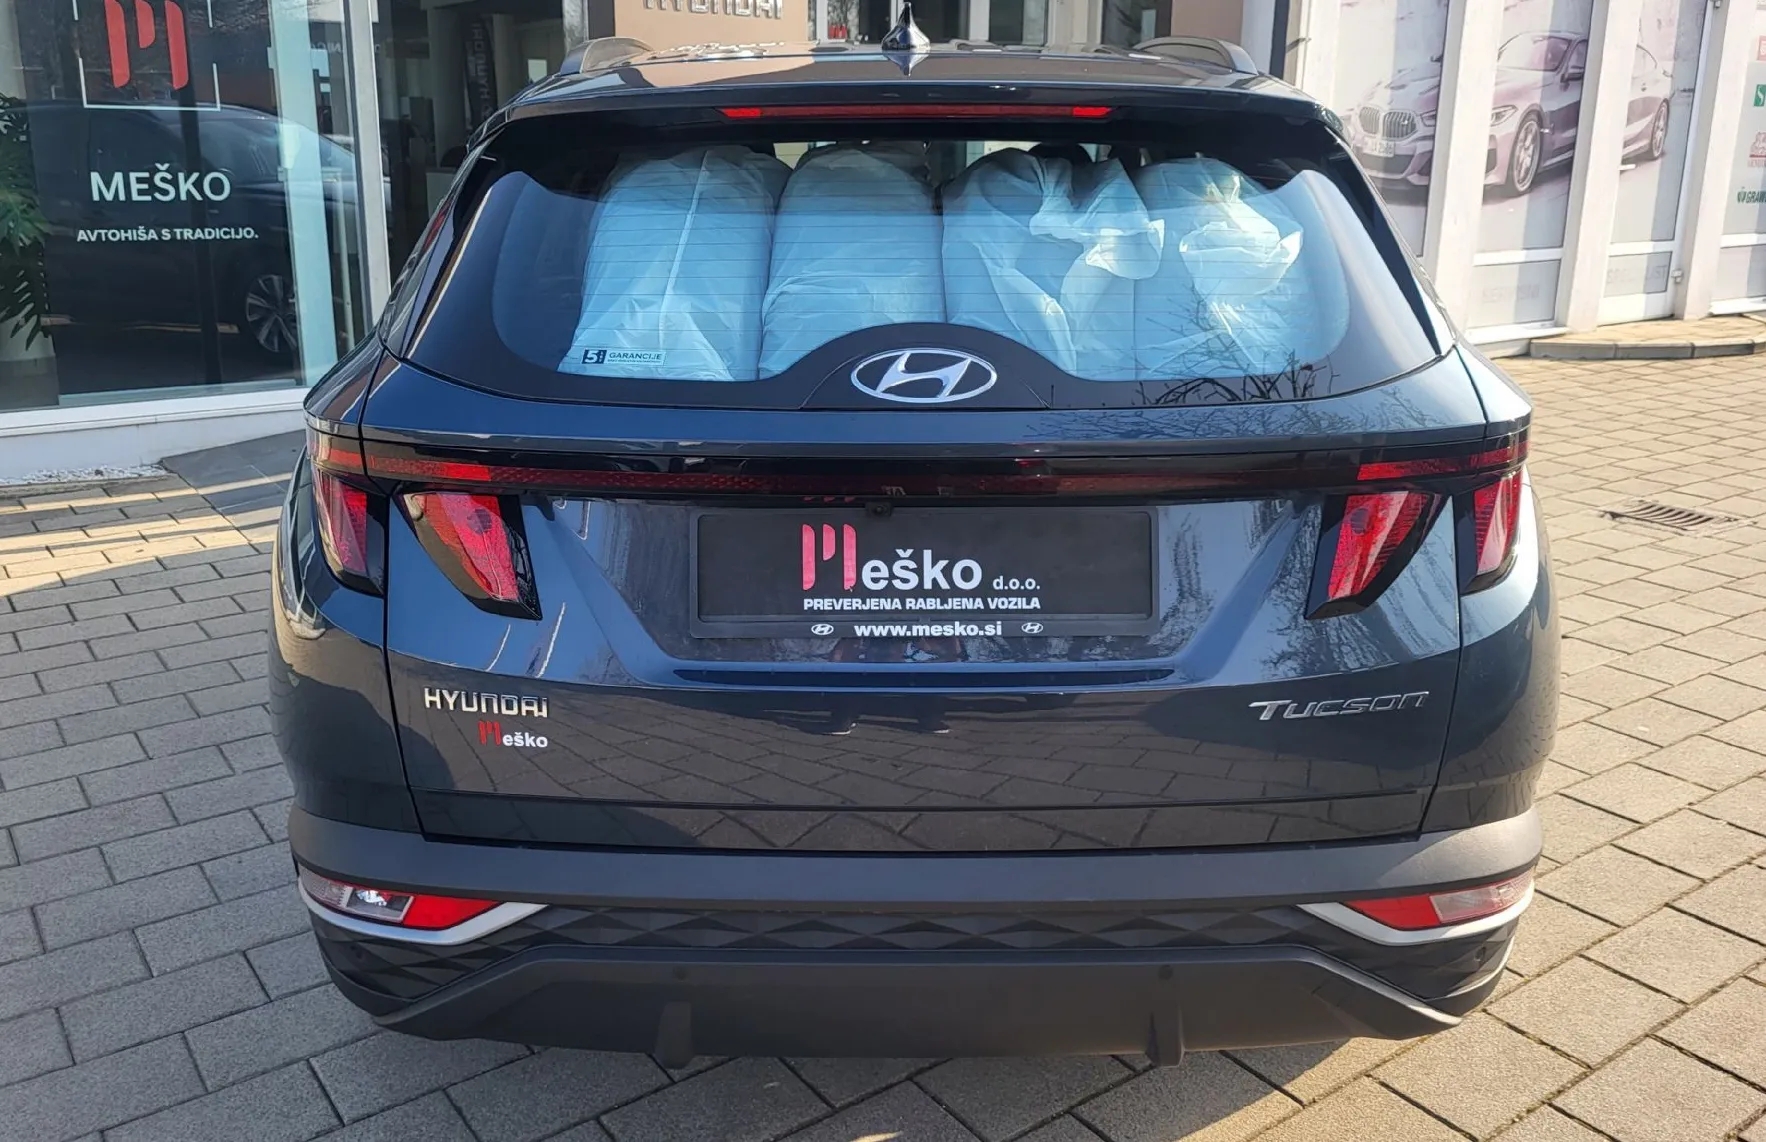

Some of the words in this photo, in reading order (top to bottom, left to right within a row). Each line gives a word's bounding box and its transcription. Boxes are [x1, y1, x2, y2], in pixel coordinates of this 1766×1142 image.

[643, 0, 782, 19] UNDAI
[91, 164, 231, 202] MEŠKO
[77, 225, 158, 241] AVTOHIŠA
[162, 229, 171, 240] S
[174, 228, 258, 240] TRADICIJO.
[992, 575, 1041, 590] d.o.o.
[803, 598, 902, 610] PREVERJENA
[905, 598, 984, 610] RABLJENA
[987, 597, 1041, 610] VOZILA
[854, 621, 1002, 637] www.mesko.si
[423, 688, 548, 718] HYUNDAI
